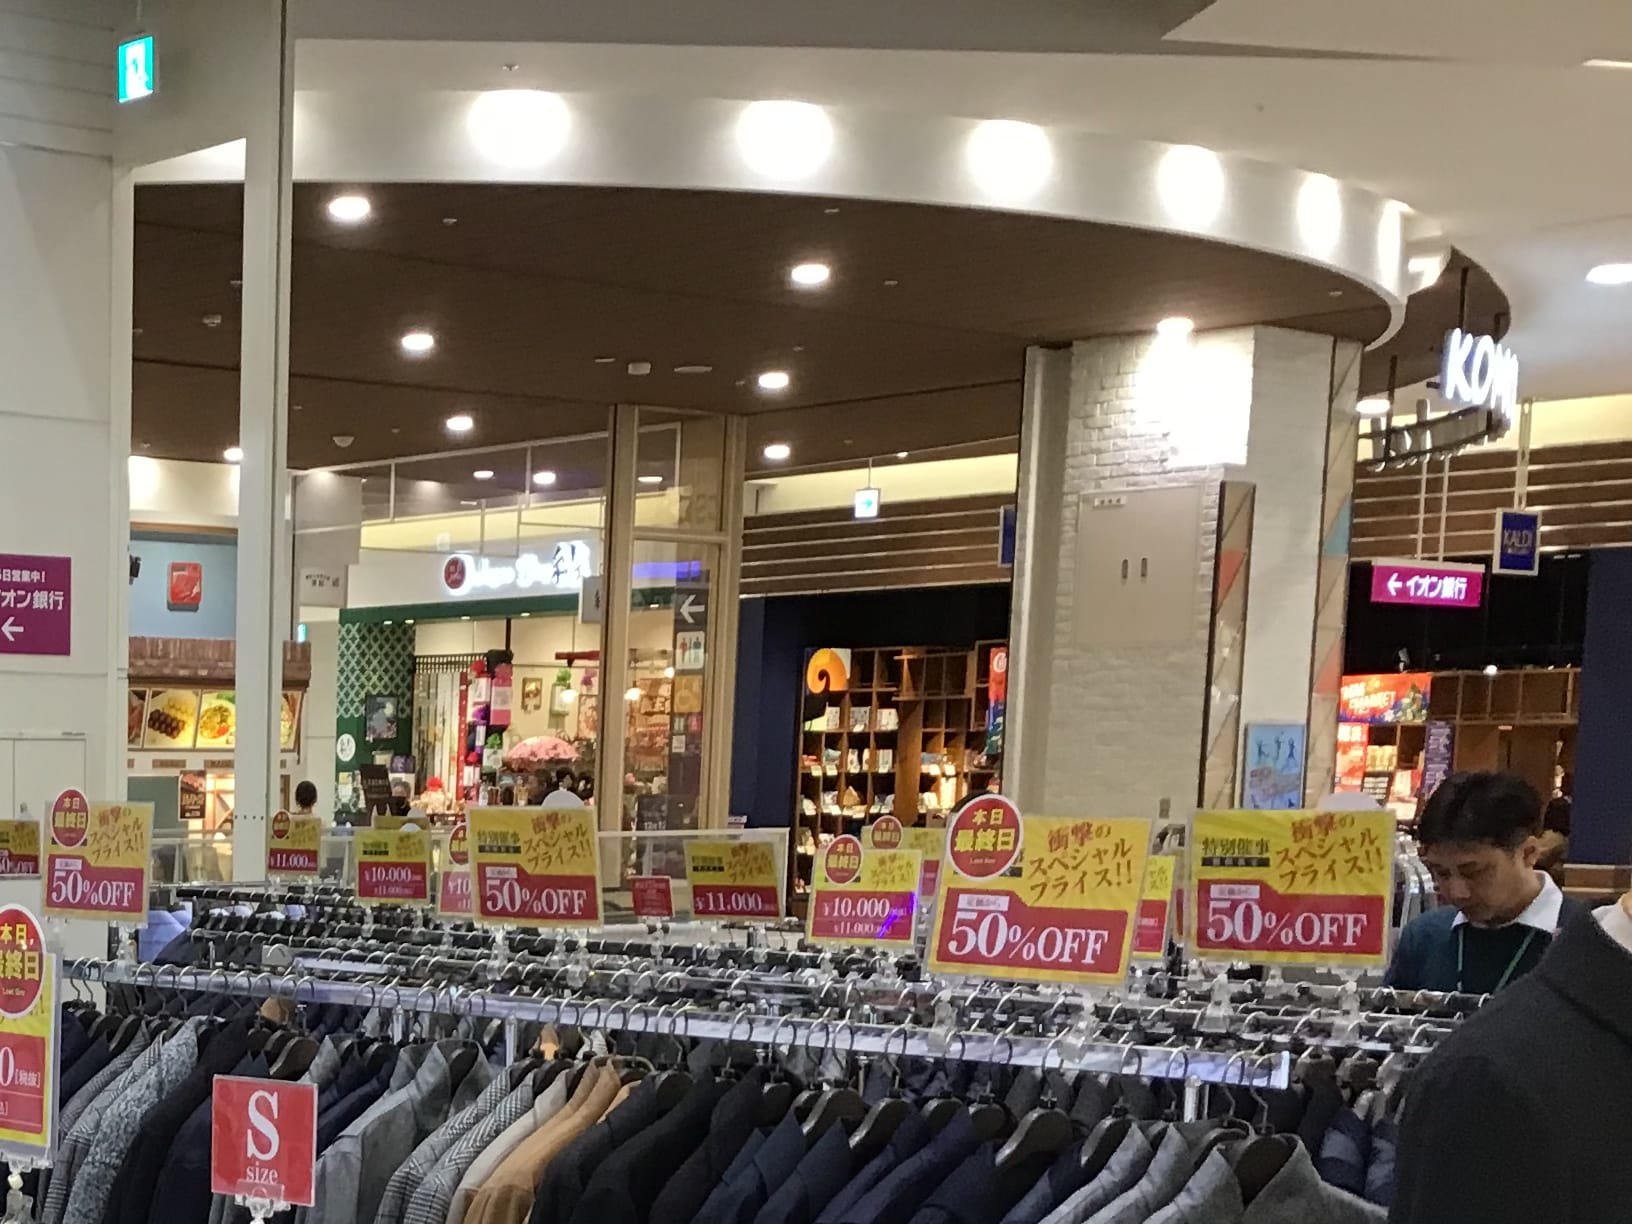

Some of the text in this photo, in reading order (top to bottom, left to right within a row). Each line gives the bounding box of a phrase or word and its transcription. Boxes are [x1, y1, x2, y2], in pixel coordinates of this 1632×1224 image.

[1406, 574, 1467, 600] イオン銀行
[62, 797, 81, 809] 本日
[972, 809, 1004, 826] 本日
[954, 828, 1016, 852] 最終日
[1028, 838, 1134, 878] スペシャル
[51, 870, 135, 907] 50%OFF
[486, 879, 587, 916] 50%OFF
[0, 922, 27, 945] 本日
[947, 911, 1109, 965] 50%OFF
[1206, 900, 1368, 947] 50%OFF
[246, 1089, 280, 1161] S
[246, 1161, 278, 1185] size
